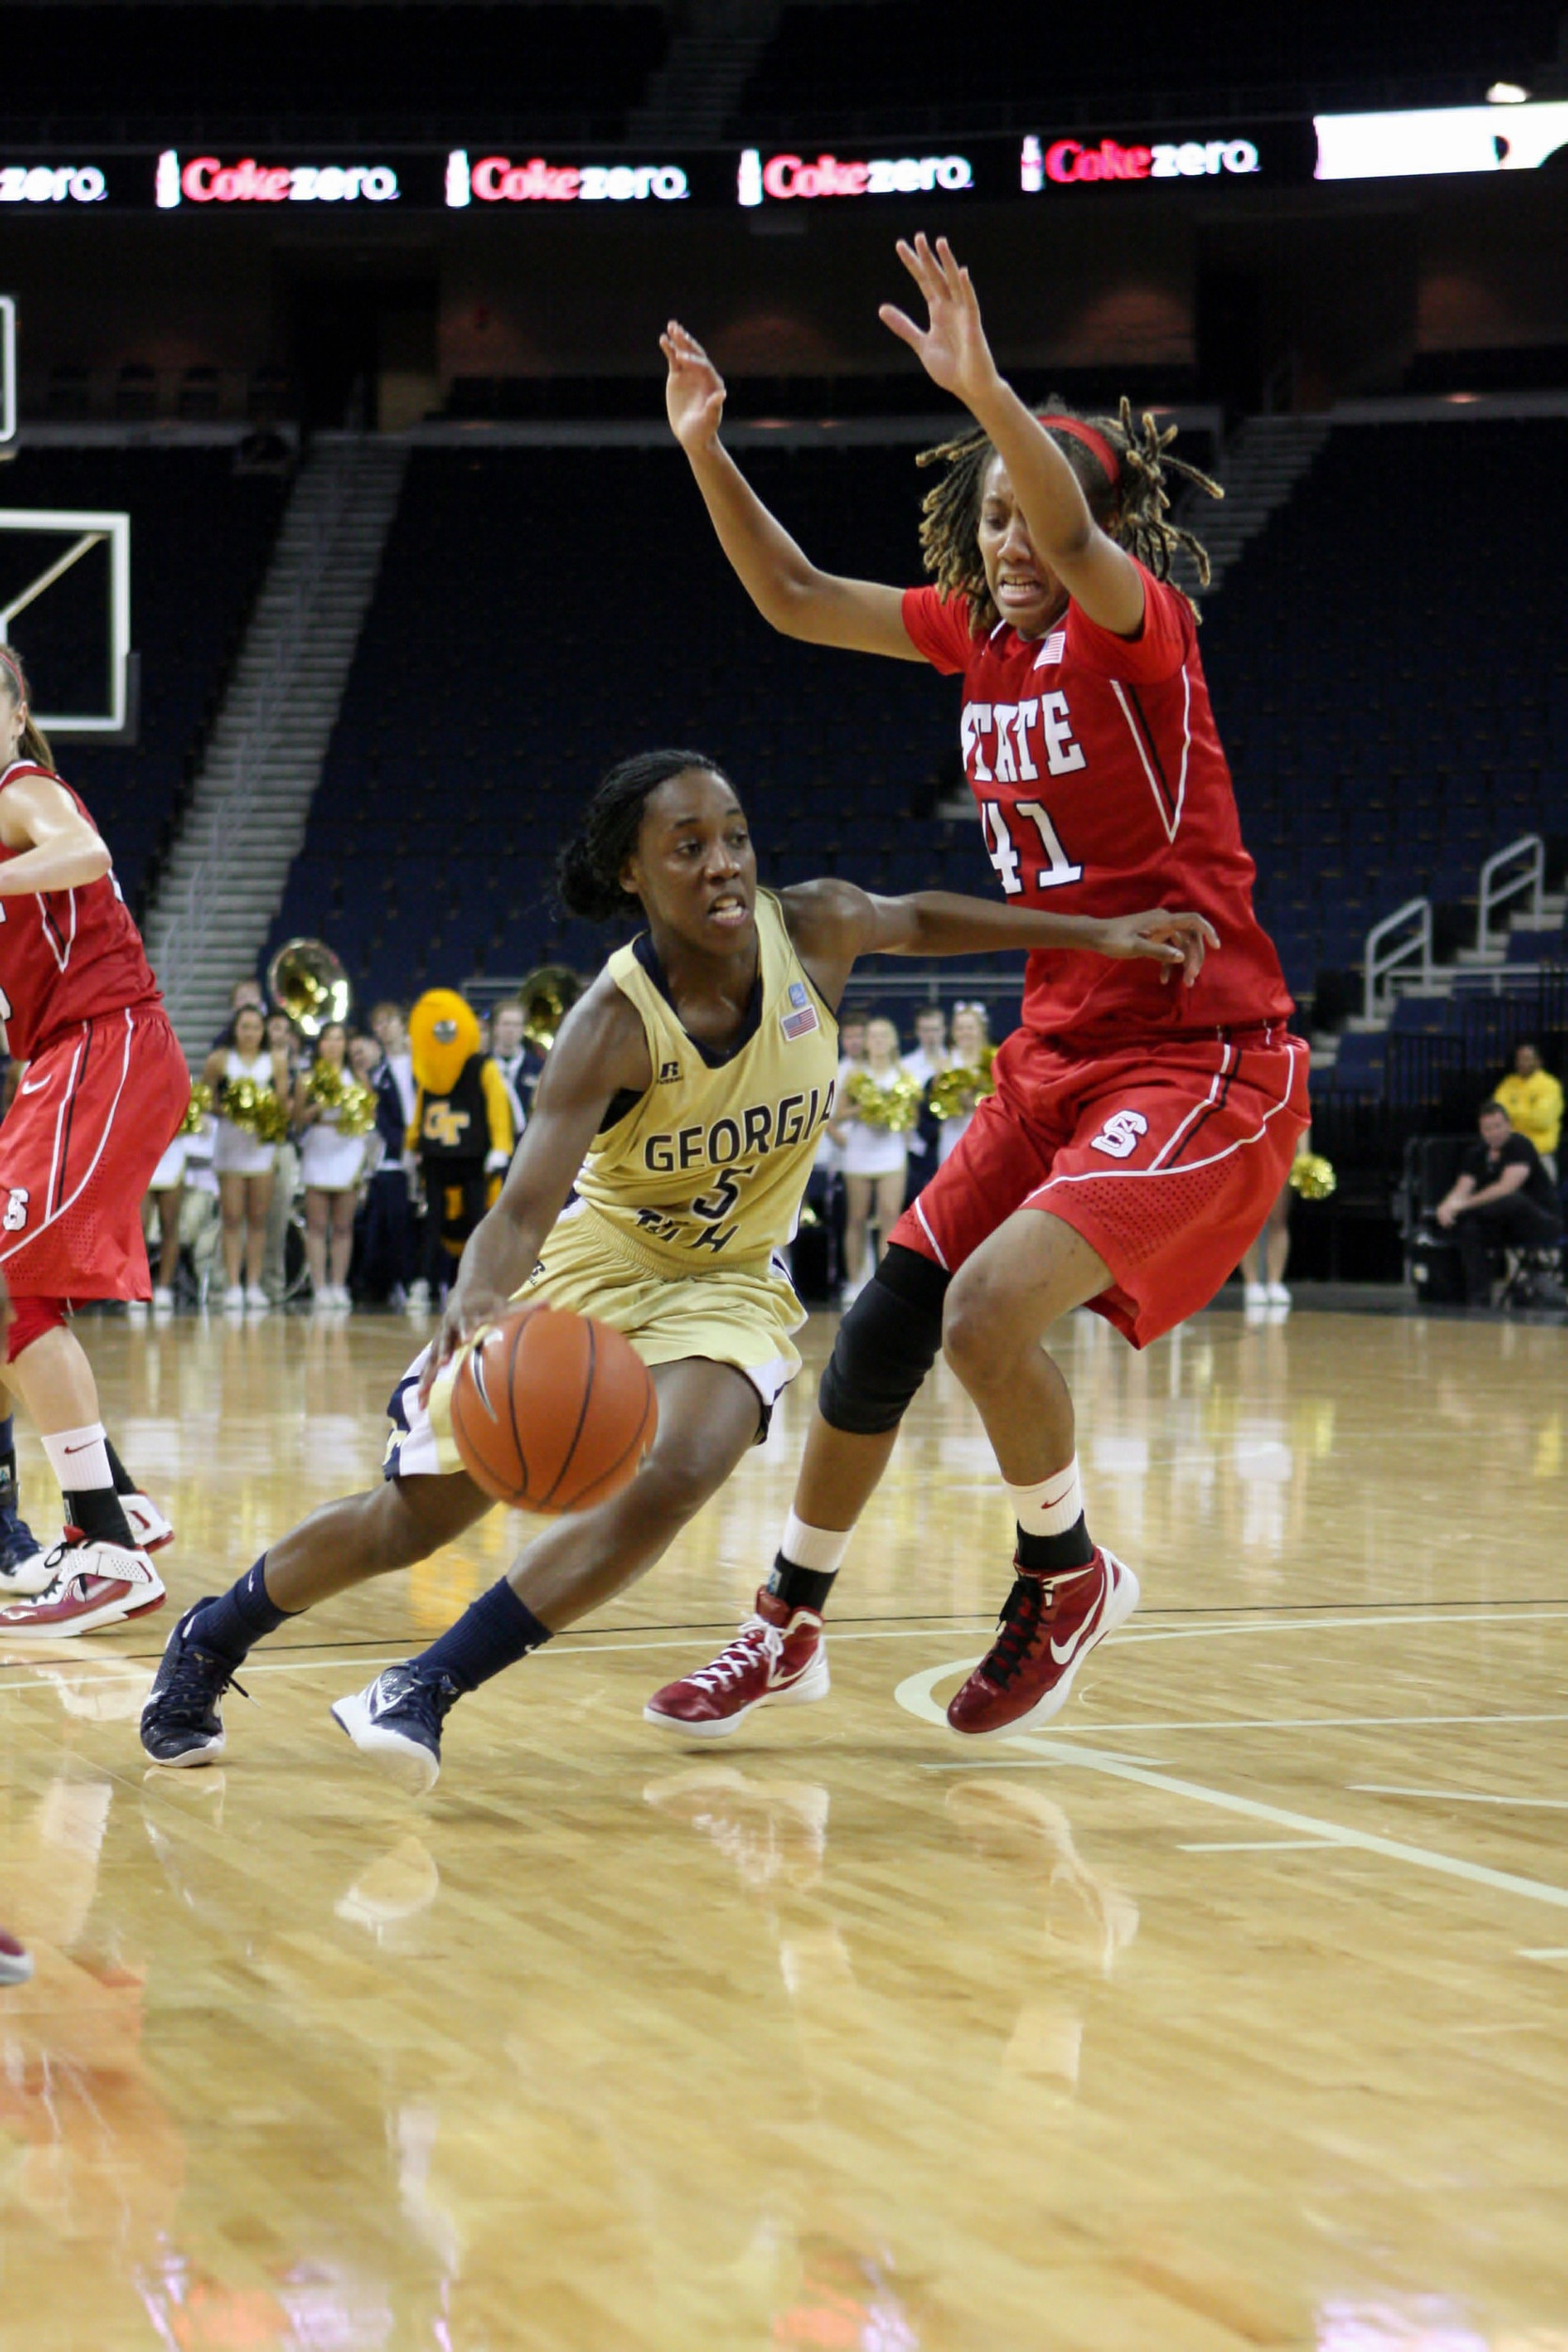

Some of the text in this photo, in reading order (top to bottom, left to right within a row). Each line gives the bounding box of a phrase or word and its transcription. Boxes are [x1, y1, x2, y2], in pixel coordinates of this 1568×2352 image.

[980, 800, 1083, 895] 41
[644, 1078, 836, 1172] GEORGIA
[690, 1162, 757, 1222] 5
